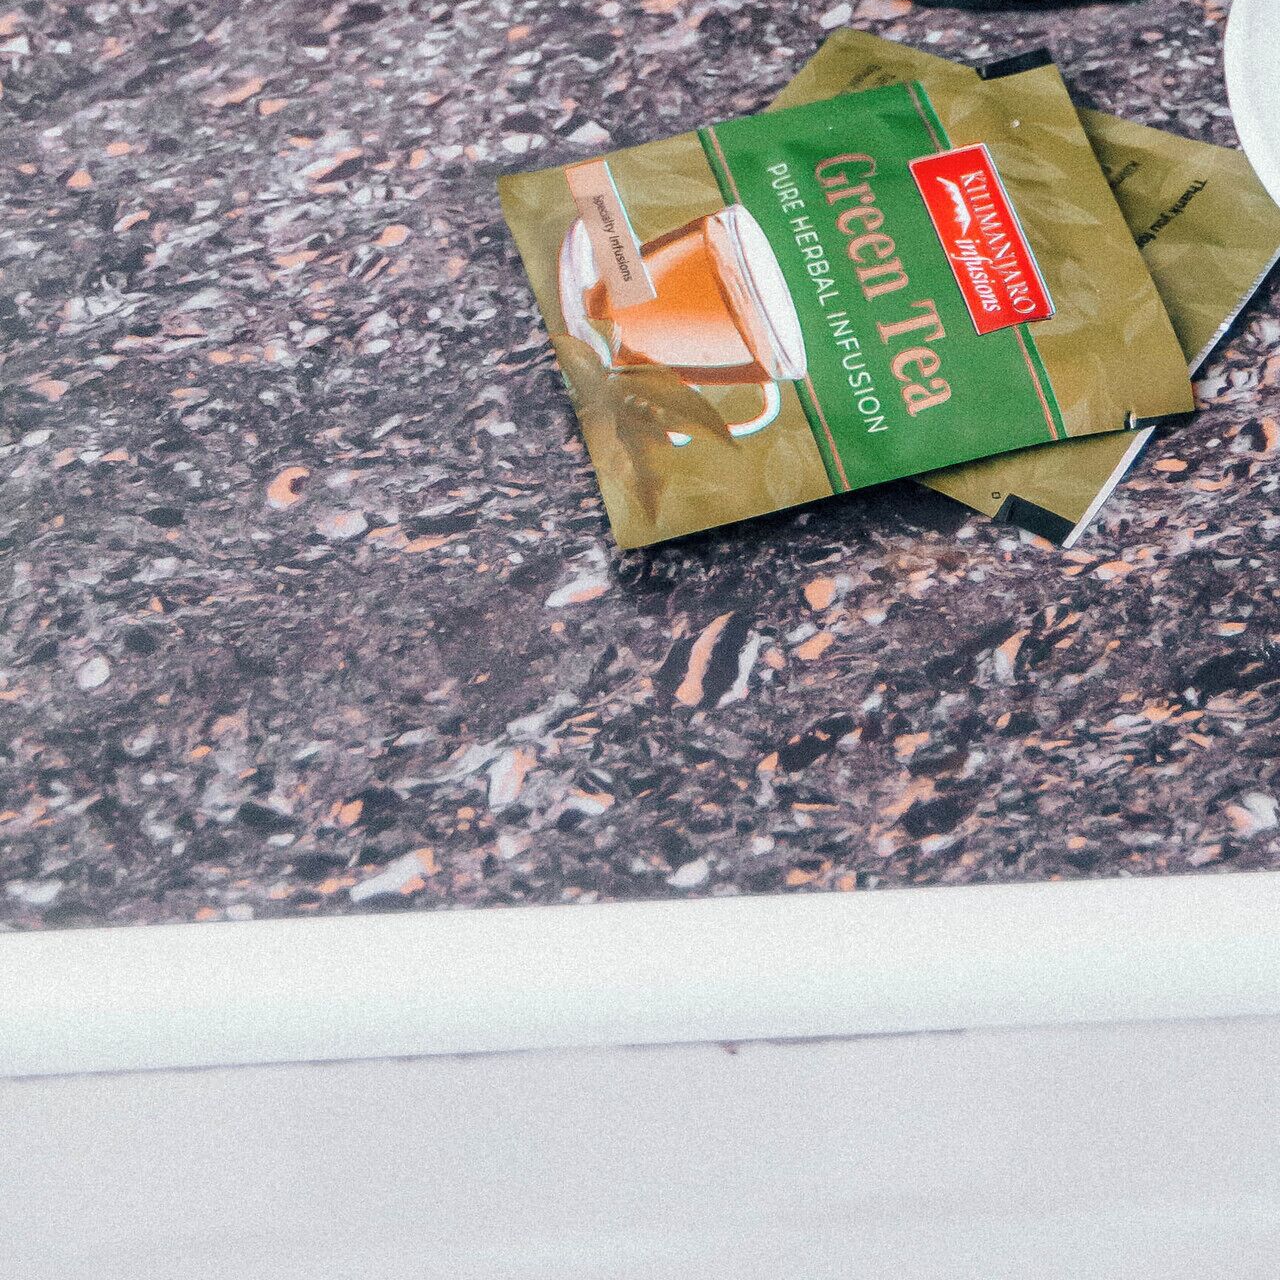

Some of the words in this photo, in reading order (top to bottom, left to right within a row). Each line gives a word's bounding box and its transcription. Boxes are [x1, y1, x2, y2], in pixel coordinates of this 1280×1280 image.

[609, 235, 632, 282] Infusions
[766, 160, 804, 214] PURE
[790, 216, 839, 307] HERBAL
[826, 311, 888, 433] INFUSION
[814, 153, 909, 303] Green
[876, 298, 951, 417] Tea
[951, 239, 1001, 313] infusions
[961, 170, 1036, 314] KILIMANJARO
